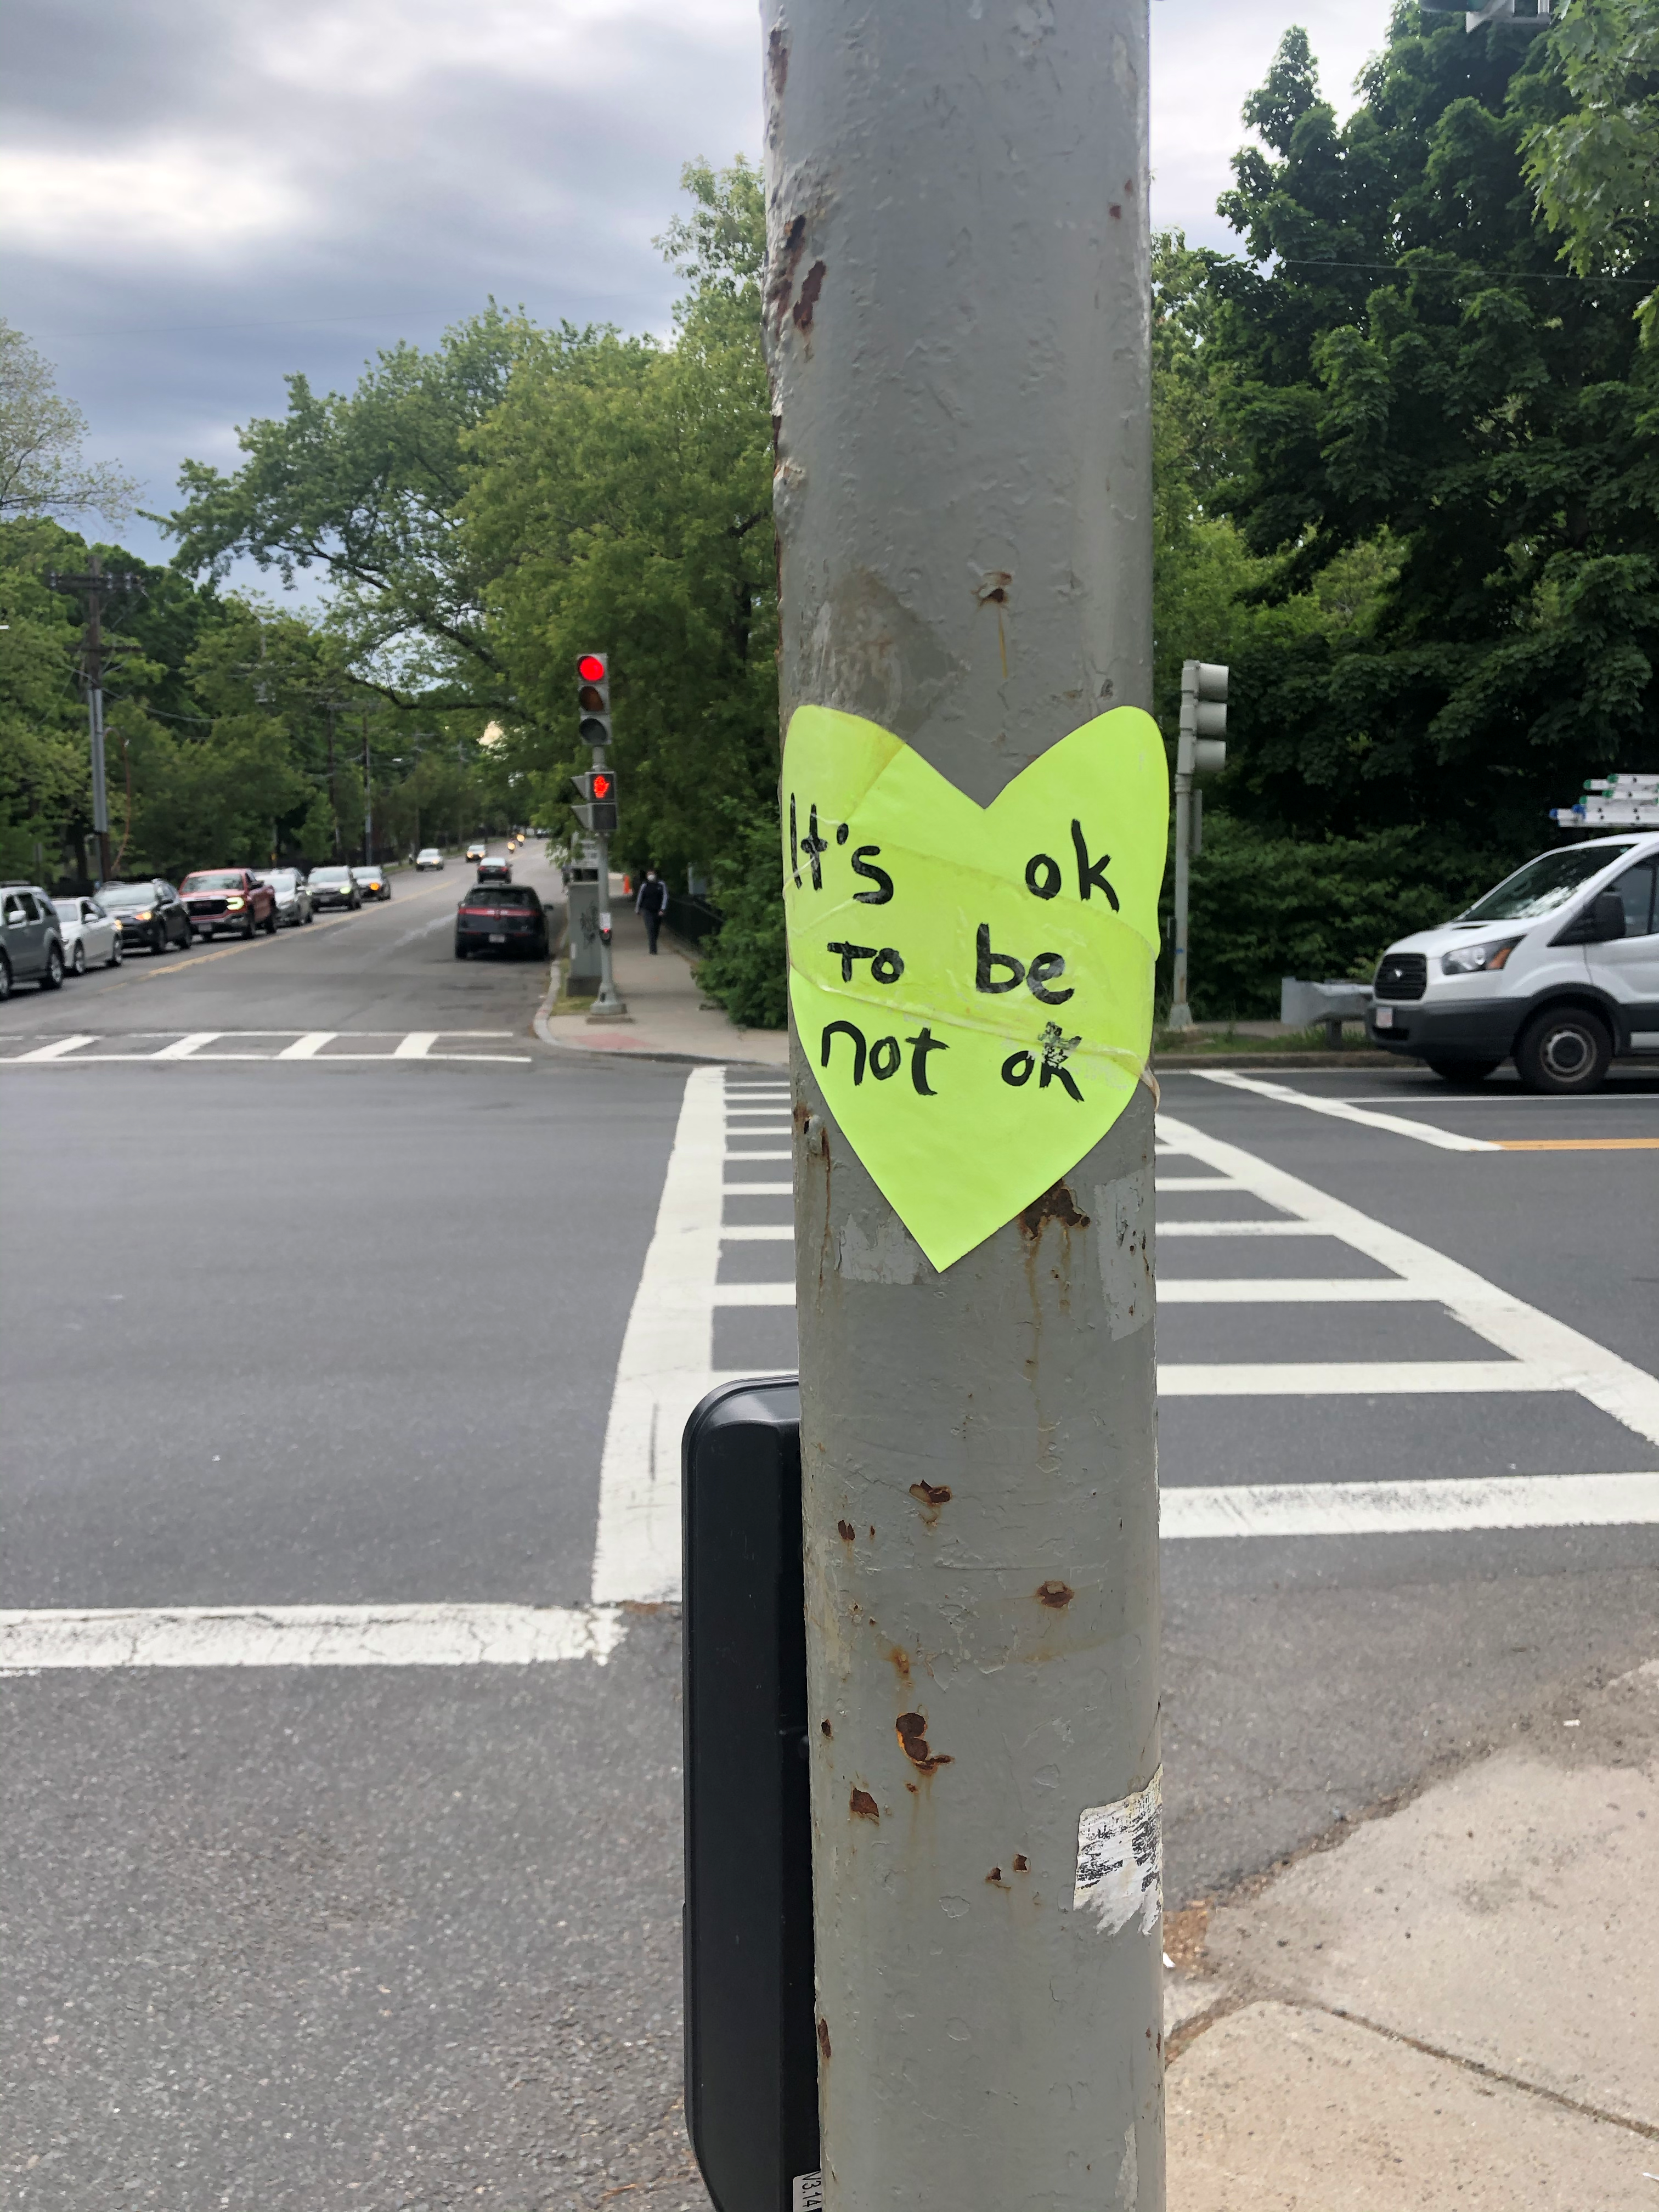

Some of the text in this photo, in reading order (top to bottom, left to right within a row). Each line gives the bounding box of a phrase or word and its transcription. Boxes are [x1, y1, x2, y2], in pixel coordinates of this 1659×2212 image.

[789, 793, 1120, 913] It's ok
[975, 923, 1075, 1005] be
[821, 1020, 1085, 1103] not ok
